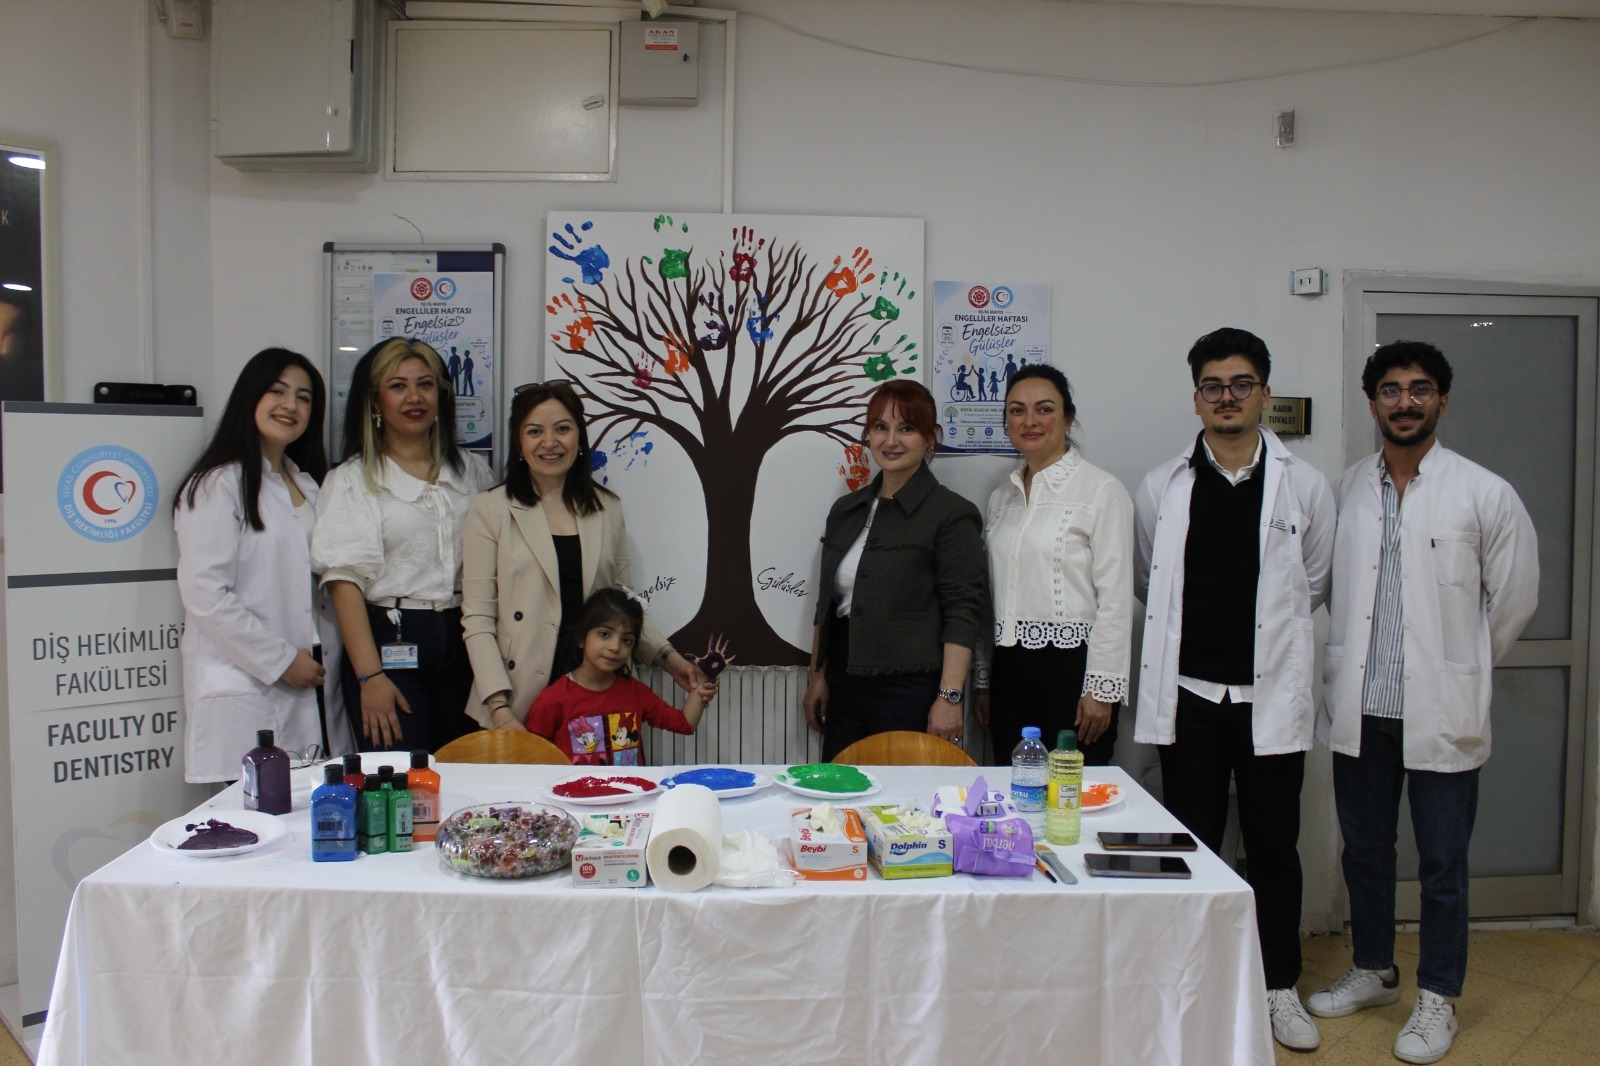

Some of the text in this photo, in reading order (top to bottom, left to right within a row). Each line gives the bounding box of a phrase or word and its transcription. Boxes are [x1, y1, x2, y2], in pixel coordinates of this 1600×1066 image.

[395, 307, 472, 315] ENGELLİLER HAFTASI
[954, 313, 1028, 323] ENGELLİLER HAFTASI
[404, 315, 456, 335] Engelsiz
[962, 323, 1014, 341] Engelsiz
[969, 336, 1016, 356] Gülüşler
[1273, 404, 1292, 413] KADIN
[1268, 415, 1295, 424] TUVALET
[64, 502, 153, 540] DİŞ HEKİMLİĞİ FAKÜLTESİ
[33, 632, 70, 664] DİŞ
[56, 660, 167, 696] FAKÜLTESİ
[48, 711, 177, 747] FACULTY OF
[54, 746, 174, 783] DENTISTRY
[800, 844, 827, 853] Beybi
[852, 845, 859, 853] S
[890, 842, 928, 853] Dolphin
[938, 839, 947, 849] S
[982, 837, 1015, 852] herbal
